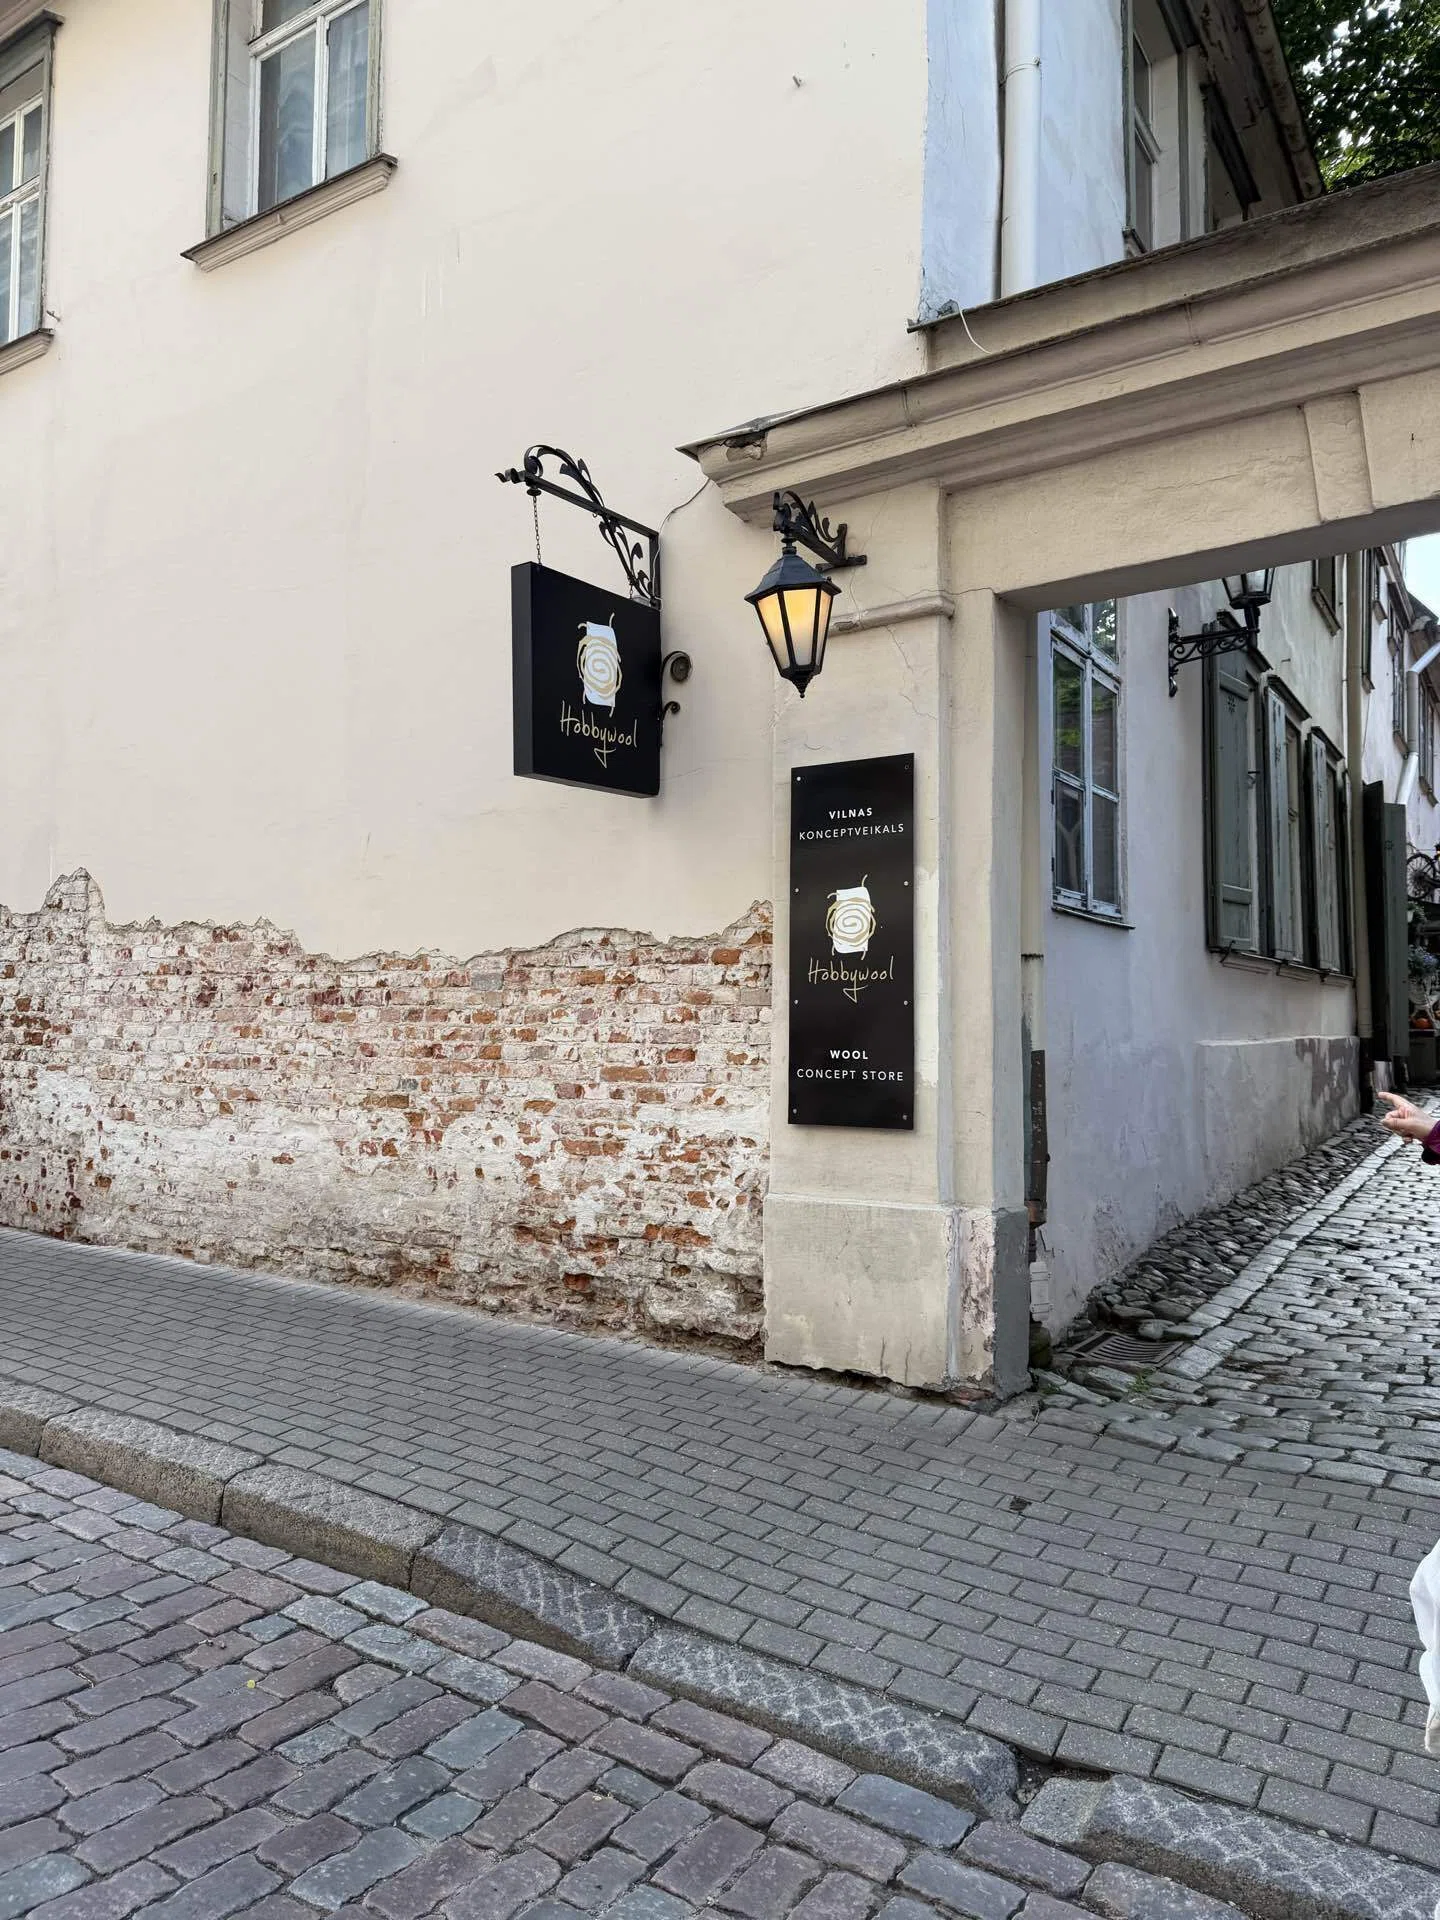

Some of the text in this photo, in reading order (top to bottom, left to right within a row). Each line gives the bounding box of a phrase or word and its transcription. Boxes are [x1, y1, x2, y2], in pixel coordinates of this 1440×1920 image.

[560, 700, 637, 768] Hobbywool
[829, 807, 873, 819] VILNAS
[799, 823, 904, 840] KONCEPTVEIKALS
[808, 955, 894, 1004] Hobbywool
[830, 1049, 869, 1060] WOOL
[797, 1069, 904, 1080] CONCEPT STORE
